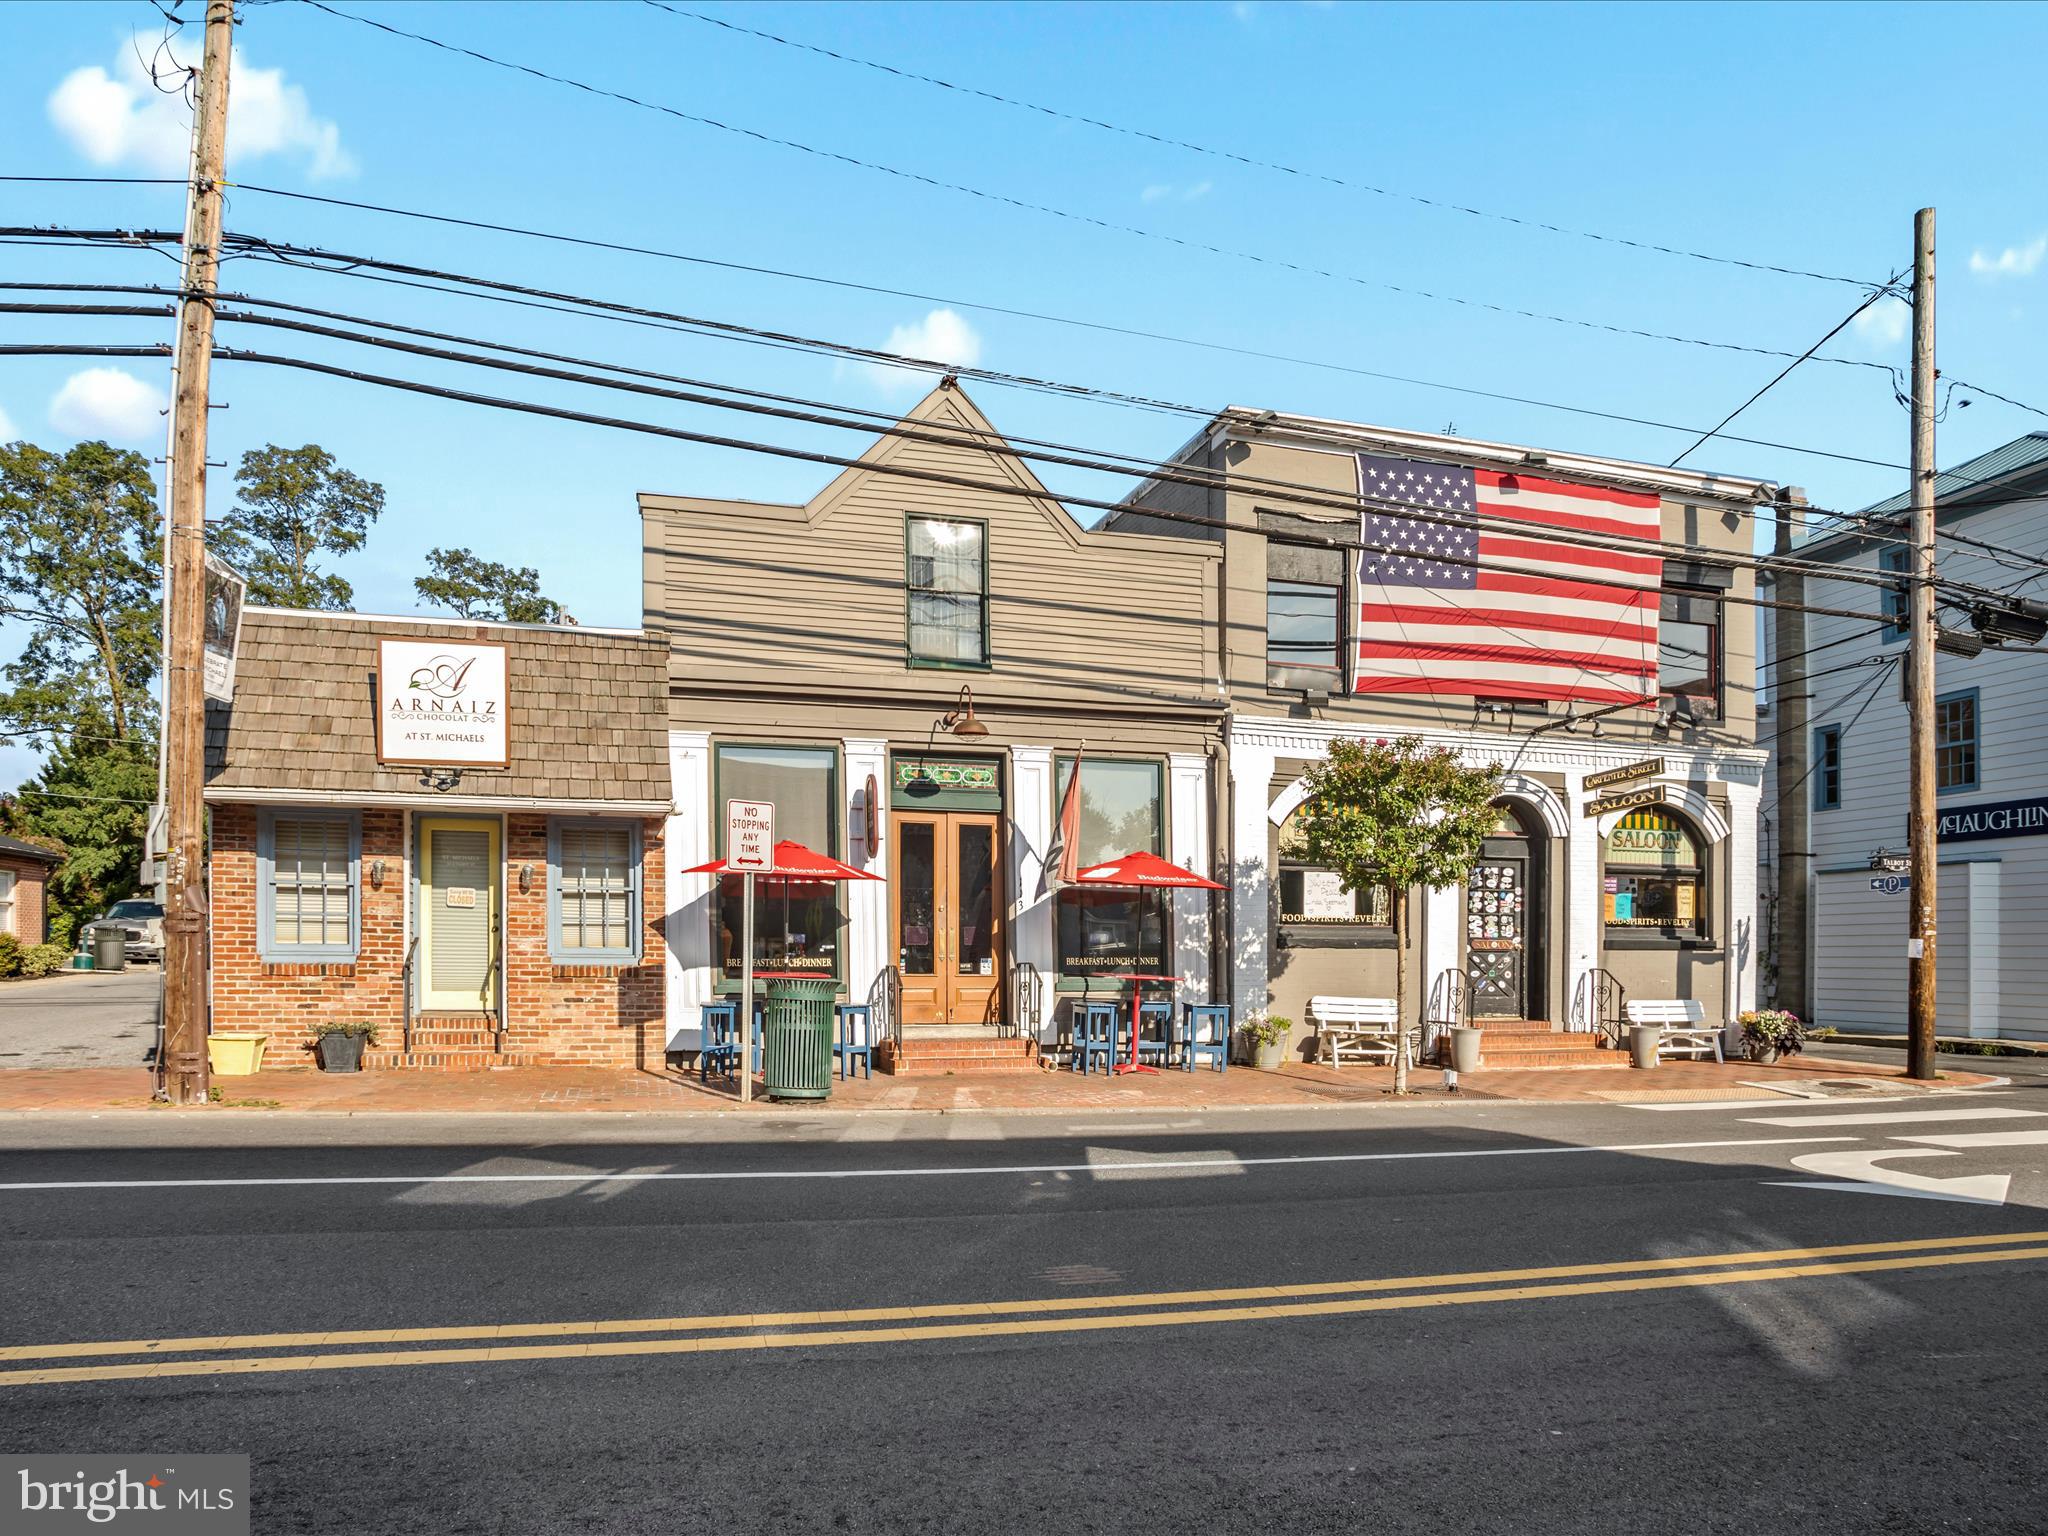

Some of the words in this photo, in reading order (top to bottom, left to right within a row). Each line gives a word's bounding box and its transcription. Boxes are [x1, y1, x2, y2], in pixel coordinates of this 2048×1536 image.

[392, 698, 496, 714] ARNAIZ
[416, 713, 468, 722] CHOCOLAT
[405, 732, 417, 741] AT
[420, 732, 434, 741] ST.
[435, 733, 485, 743] MICHAELS
[1585, 769, 1627, 788] CARPENTER
[1627, 762, 1657, 779] STREET
[1589, 790, 1656, 814] SALOON
[744, 807, 758, 818] NO
[732, 818, 770, 831] STOPPING
[742, 833, 759, 841] ANY
[1612, 831, 1680, 850] SALOON
[741, 844, 760, 854] TIME
[1883, 858, 1905, 866] TALBOT
[1137, 874, 1198, 884] Budweiser
[1888, 878, 1897, 890] P
[448, 895, 474, 905] CLOSED
[1281, 914, 1309, 923] FOOD
[1348, 915, 1388, 924] REVELRY
[1626, 918, 1655, 926] SPIRITS
[1657, 918, 1691, 927] REVELRY
[802, 958, 832, 967] DINNER
[1066, 957, 1105, 966] BREAKFAST
[1106, 957, 1131, 966] LUNCH
